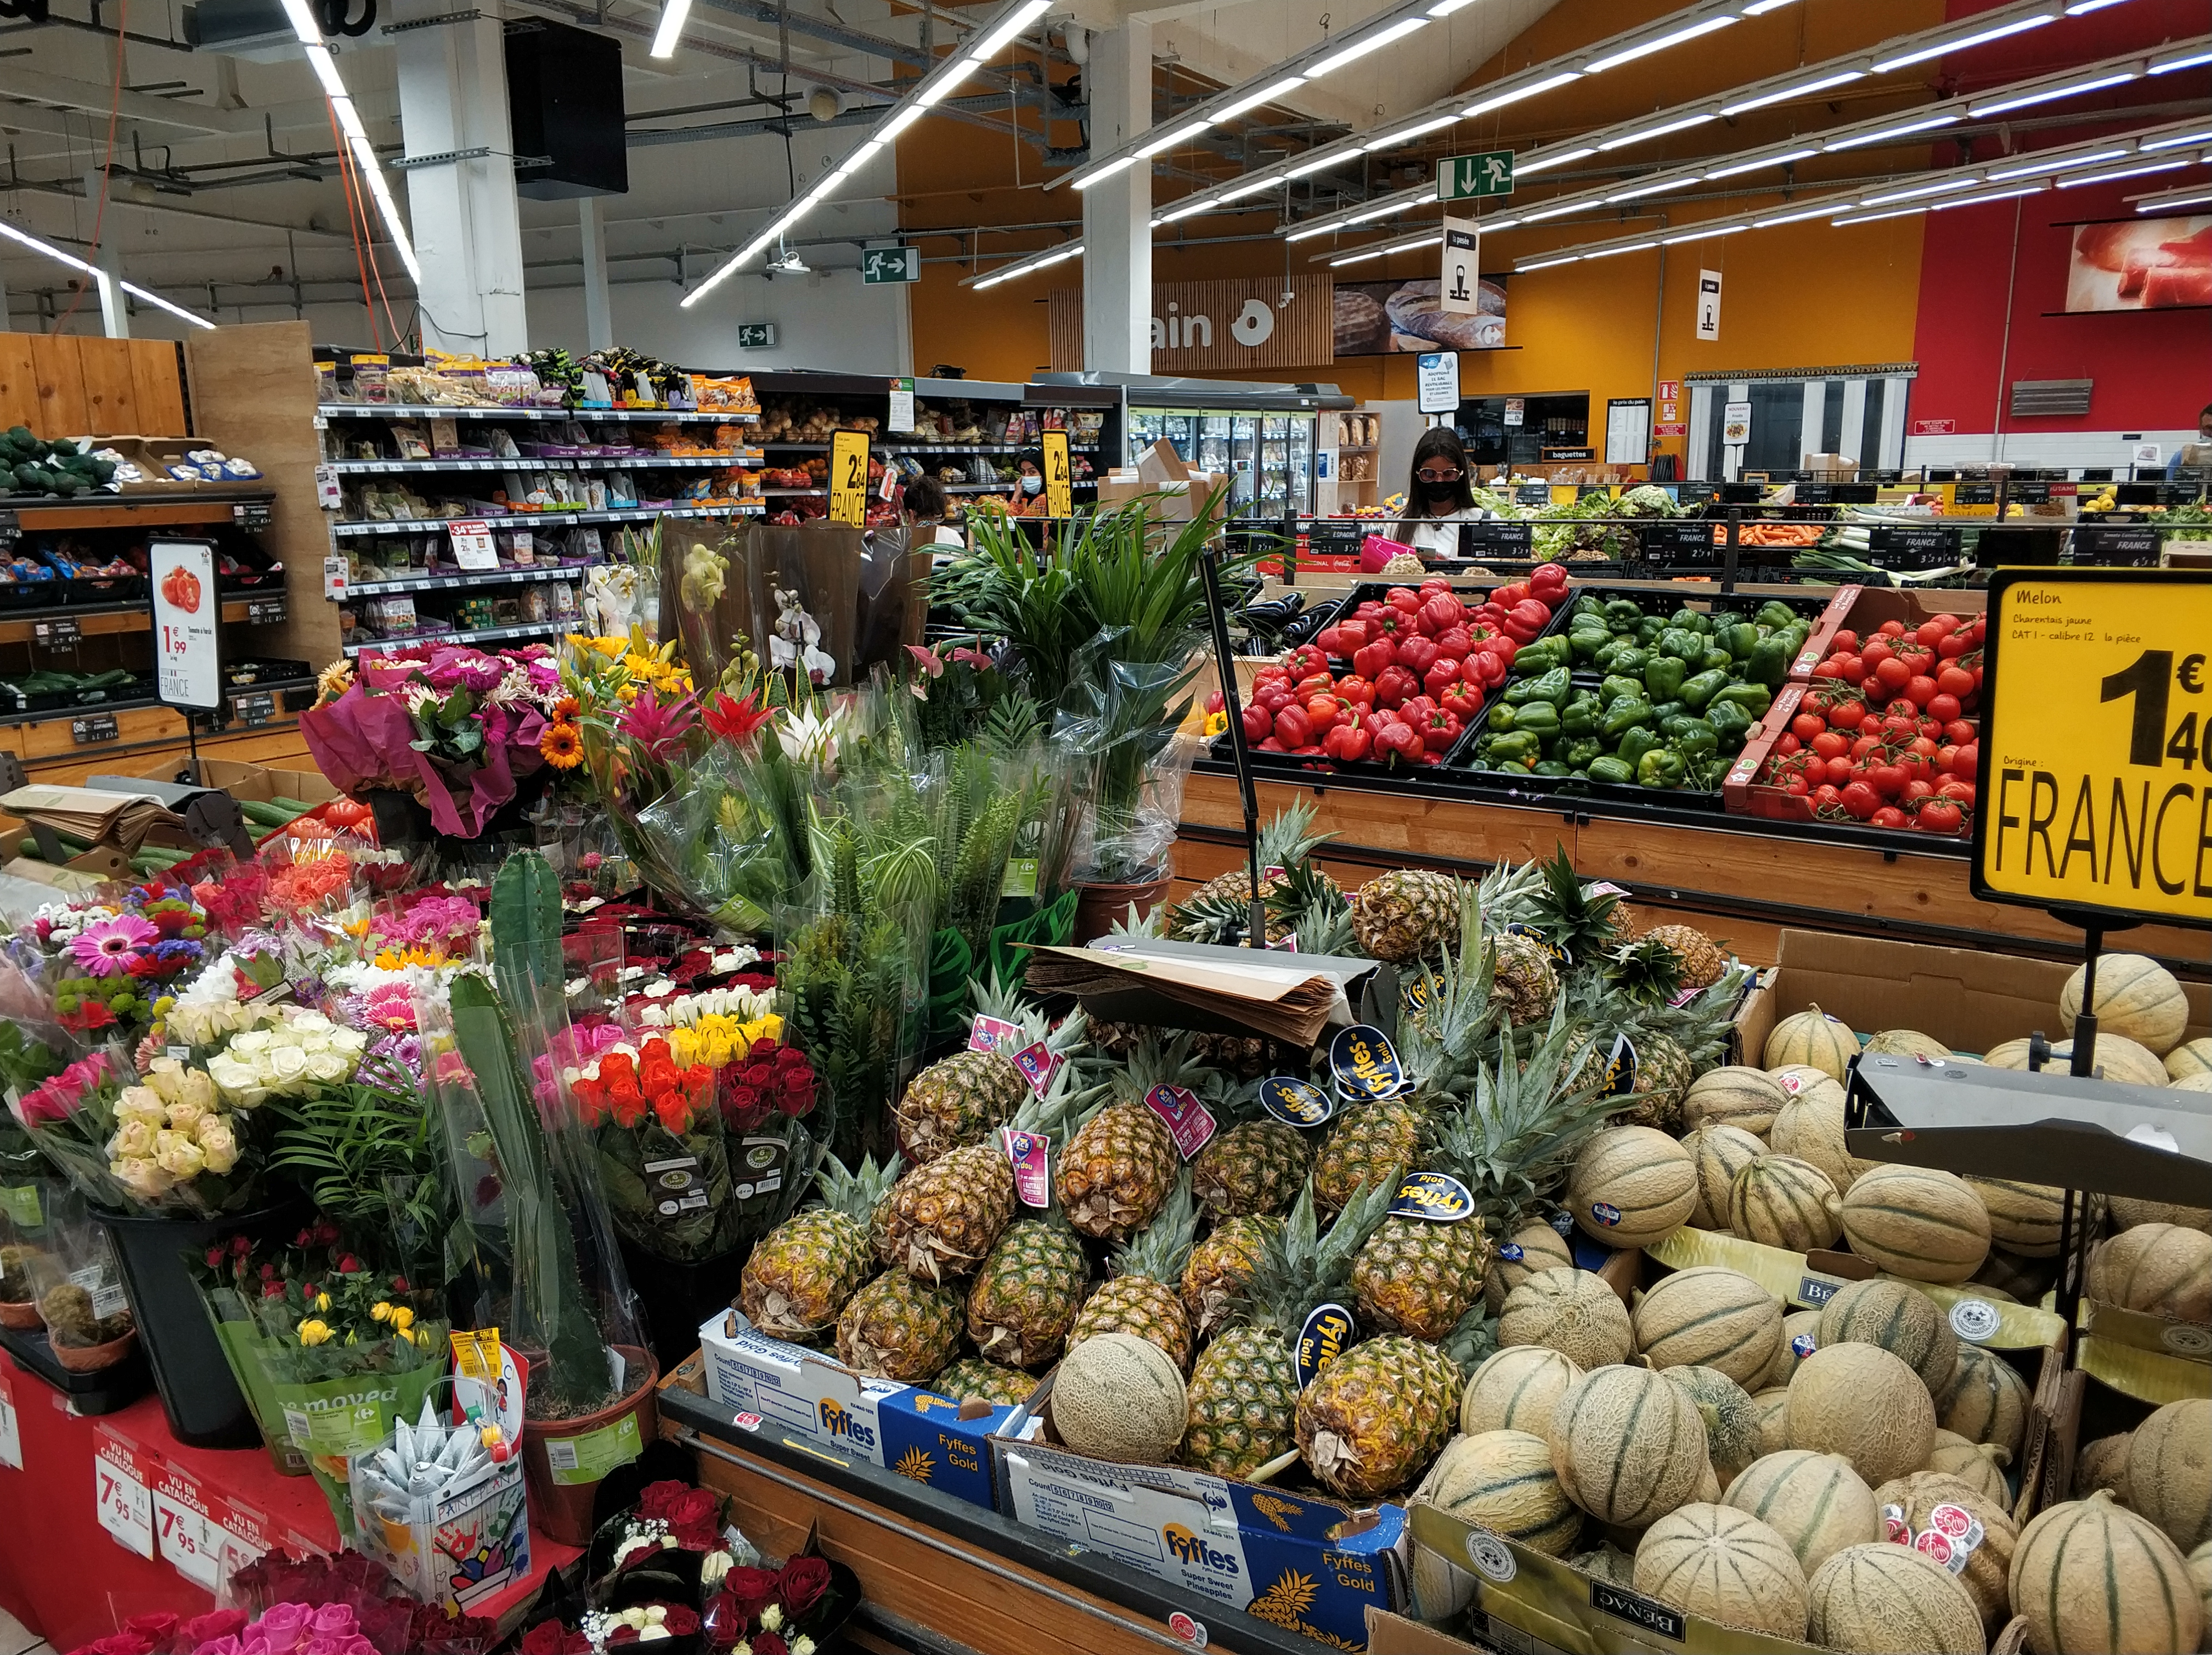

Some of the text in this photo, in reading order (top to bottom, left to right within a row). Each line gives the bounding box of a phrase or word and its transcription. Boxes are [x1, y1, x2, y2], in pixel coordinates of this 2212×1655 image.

[1457, 236, 1470, 245] pesée
[847, 454, 862, 489] 2 €
[1054, 451, 1061, 481] 2
[1060, 466, 1068, 482] 84
[856, 472, 865, 489] 84
[831, 492, 865, 526] FRANCE
[1048, 484, 1071, 514] FRANCE
[1906, 538, 1937, 546] FRANCE
[2117, 541, 2152, 549] FRANCE
[2016, 590, 2062, 604] Melon
[2013, 613, 2092, 627] Charentais jaune
[163, 626, 179, 653] 1 €
[174, 640, 186, 654] 99
[2012, 630, 2141, 645] CAT calibre 12 la pièce
[160, 677, 189, 697] FRANCE
[2100, 650, 2207, 767] 1 €
[2004, 756, 2037, 768] Origine
[1023, 1059, 1032, 1067] SCB
[1375, 1041, 1393, 1065] Gold
[1349, 1041, 1394, 1093] Fyffes
[1160, 1091, 1170, 1102] SCB
[1301, 1084, 1321, 1097] Gold
[1276, 1087, 1324, 1122] Fyffes
[1016, 1141, 1029, 1149] SCB
[1419, 1175, 1446, 1187] Gold
[1398, 1185, 1464, 1214] Fyffes
[476, 1328, 494, 1341] -50%
[735, 1339, 769, 1354] Gold
[1300, 1338, 1314, 1368] Gold
[714, 1352, 731, 1366] Count
[304, 1387, 398, 1411] moved
[109, 1440, 133, 1465] VU EN
[830, 1439, 871, 1462] Super Sweet
[939, 1433, 977, 1455] Fyffes
[100, 1446, 144, 1483] CATALOGUE
[949, 1453, 979, 1473] Gold
[100, 1471, 122, 1505] 7 €
[168, 1473, 196, 1499] VU EN
[1028, 1478, 1051, 1492] Count
[1040, 1462, 1130, 1493] Fyffes Gold
[115, 1498, 129, 1521] 95
[158, 1481, 210, 1517] CATALOGUE
[159, 1505, 184, 1539] 7 €
[231, 1511, 260, 1535] VU EN
[177, 1532, 195, 1554] 95
[223, 1516, 273, 1551] CATALOGUE
[1322, 1552, 1373, 1574] Fyffes
[1181, 1568, 1235, 1591] Super Sweet
[1186, 1580, 1233, 1601] Pineapples
[1337, 1573, 1376, 1594] Gold
[1599, 1592, 1675, 1635] BÉNAC
